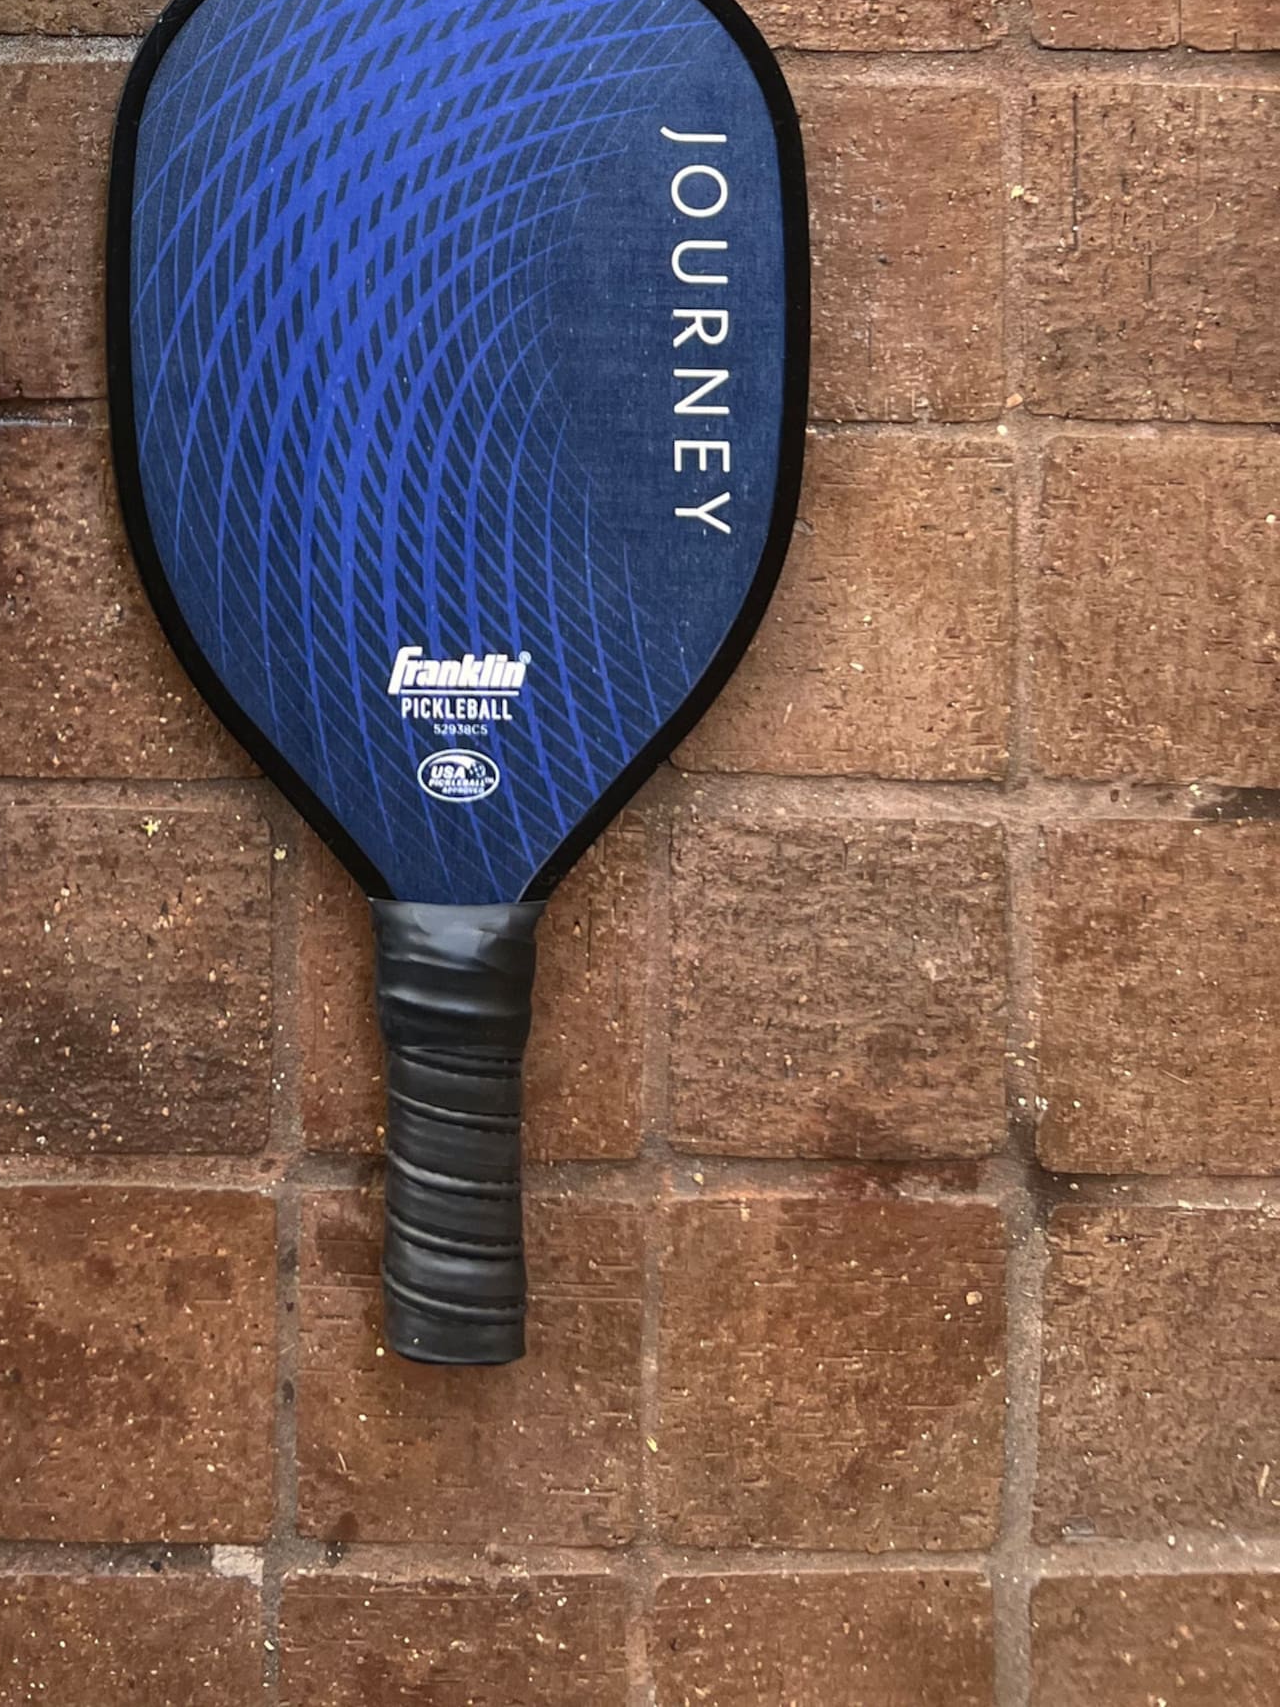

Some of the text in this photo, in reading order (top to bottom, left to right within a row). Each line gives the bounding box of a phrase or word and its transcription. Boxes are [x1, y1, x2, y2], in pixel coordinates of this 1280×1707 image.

[660, 126, 731, 534] JOURNEY
[401, 697, 513, 720] PICKLEBALL
[431, 765, 466, 779] USA
[428, 778, 485, 788] PICKLEBALL
